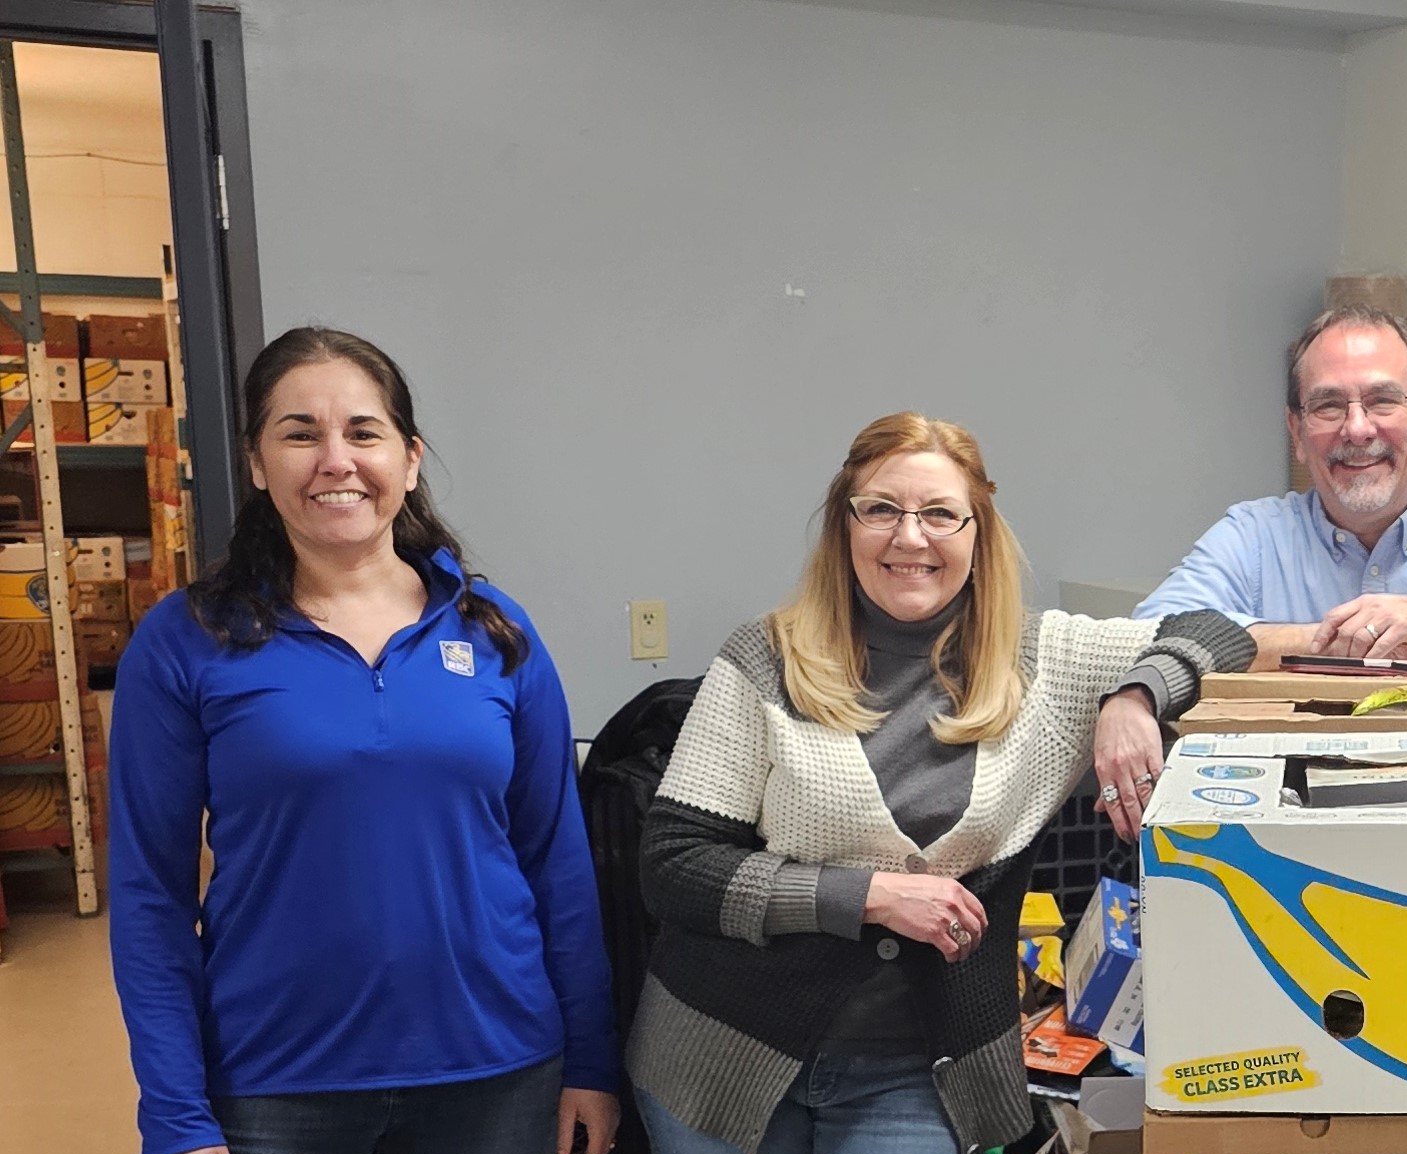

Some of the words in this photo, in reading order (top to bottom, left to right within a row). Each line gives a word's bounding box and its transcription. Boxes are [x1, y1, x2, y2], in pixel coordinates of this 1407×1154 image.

[1174, 1060, 1240, 1079] SELECTED
[1243, 1051, 1300, 1071] QUALITY
[1183, 1076, 1240, 1097] CLASS
[1243, 1068, 1304, 1089] EXTRA
